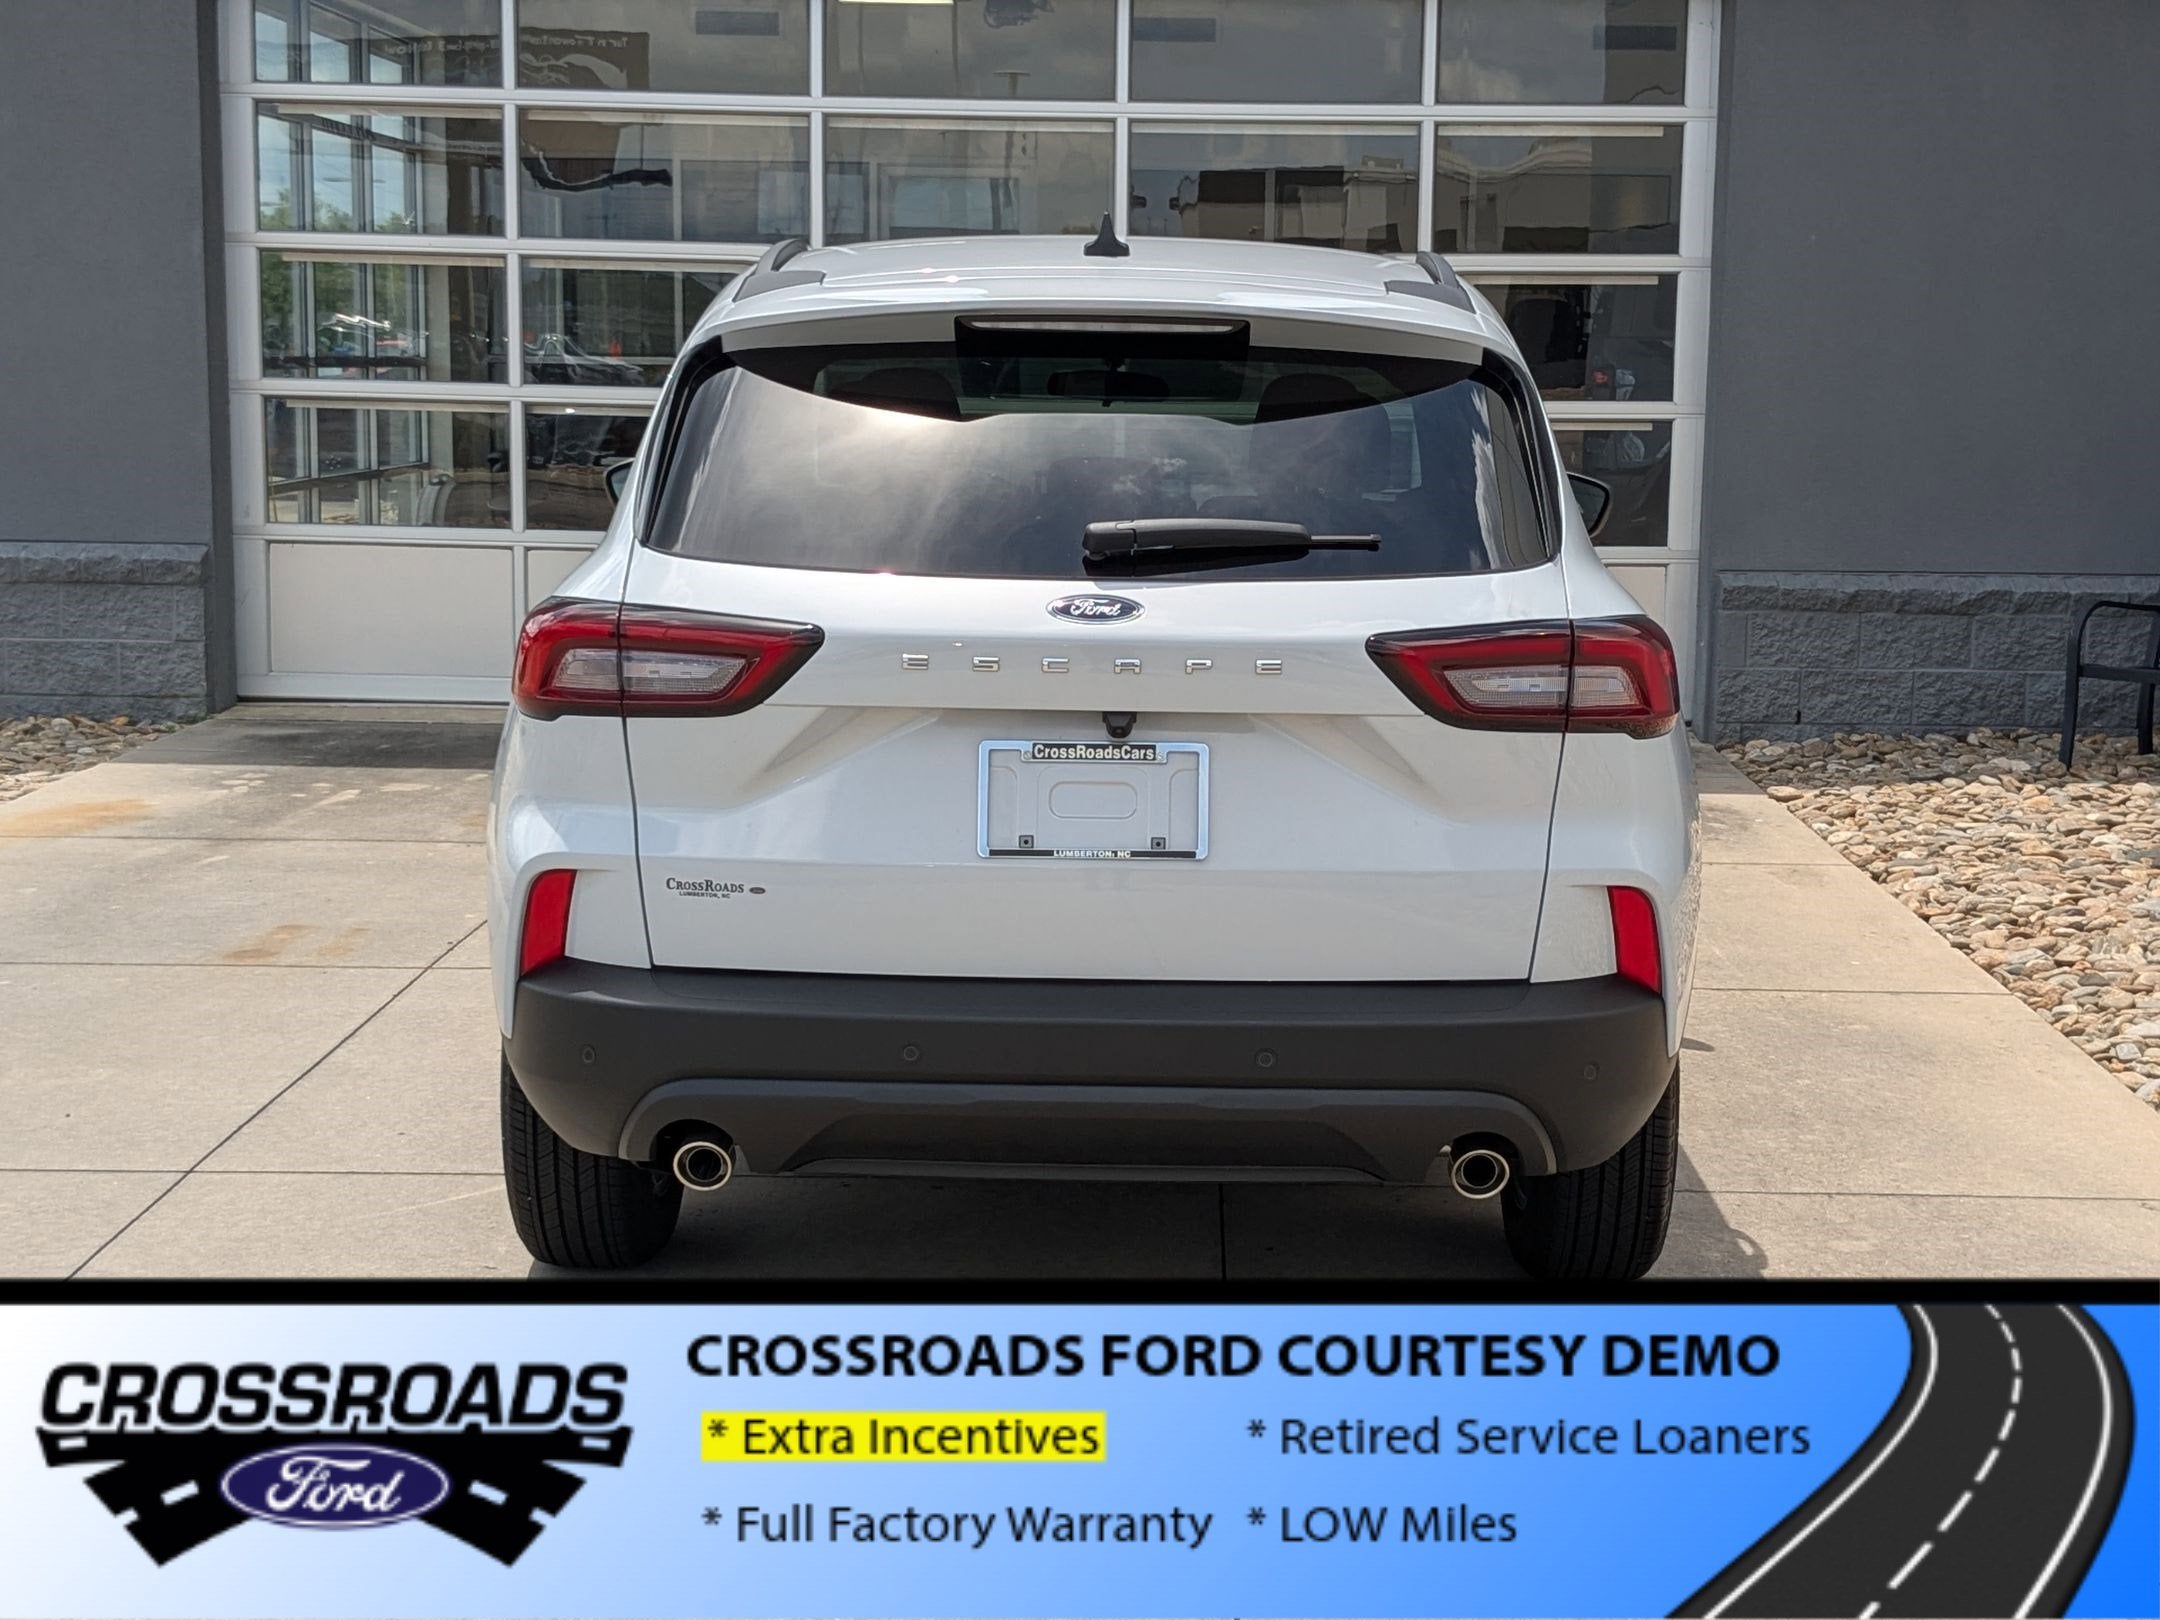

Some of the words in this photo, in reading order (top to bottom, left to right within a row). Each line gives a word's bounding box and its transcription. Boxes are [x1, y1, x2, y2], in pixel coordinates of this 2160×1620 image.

[1069, 598, 1122, 616] Ford
[901, 653, 1284, 675] ESCAPE
[1033, 744, 1155, 760] CrossRoadsCars
[1117, 850, 1131, 858] NC
